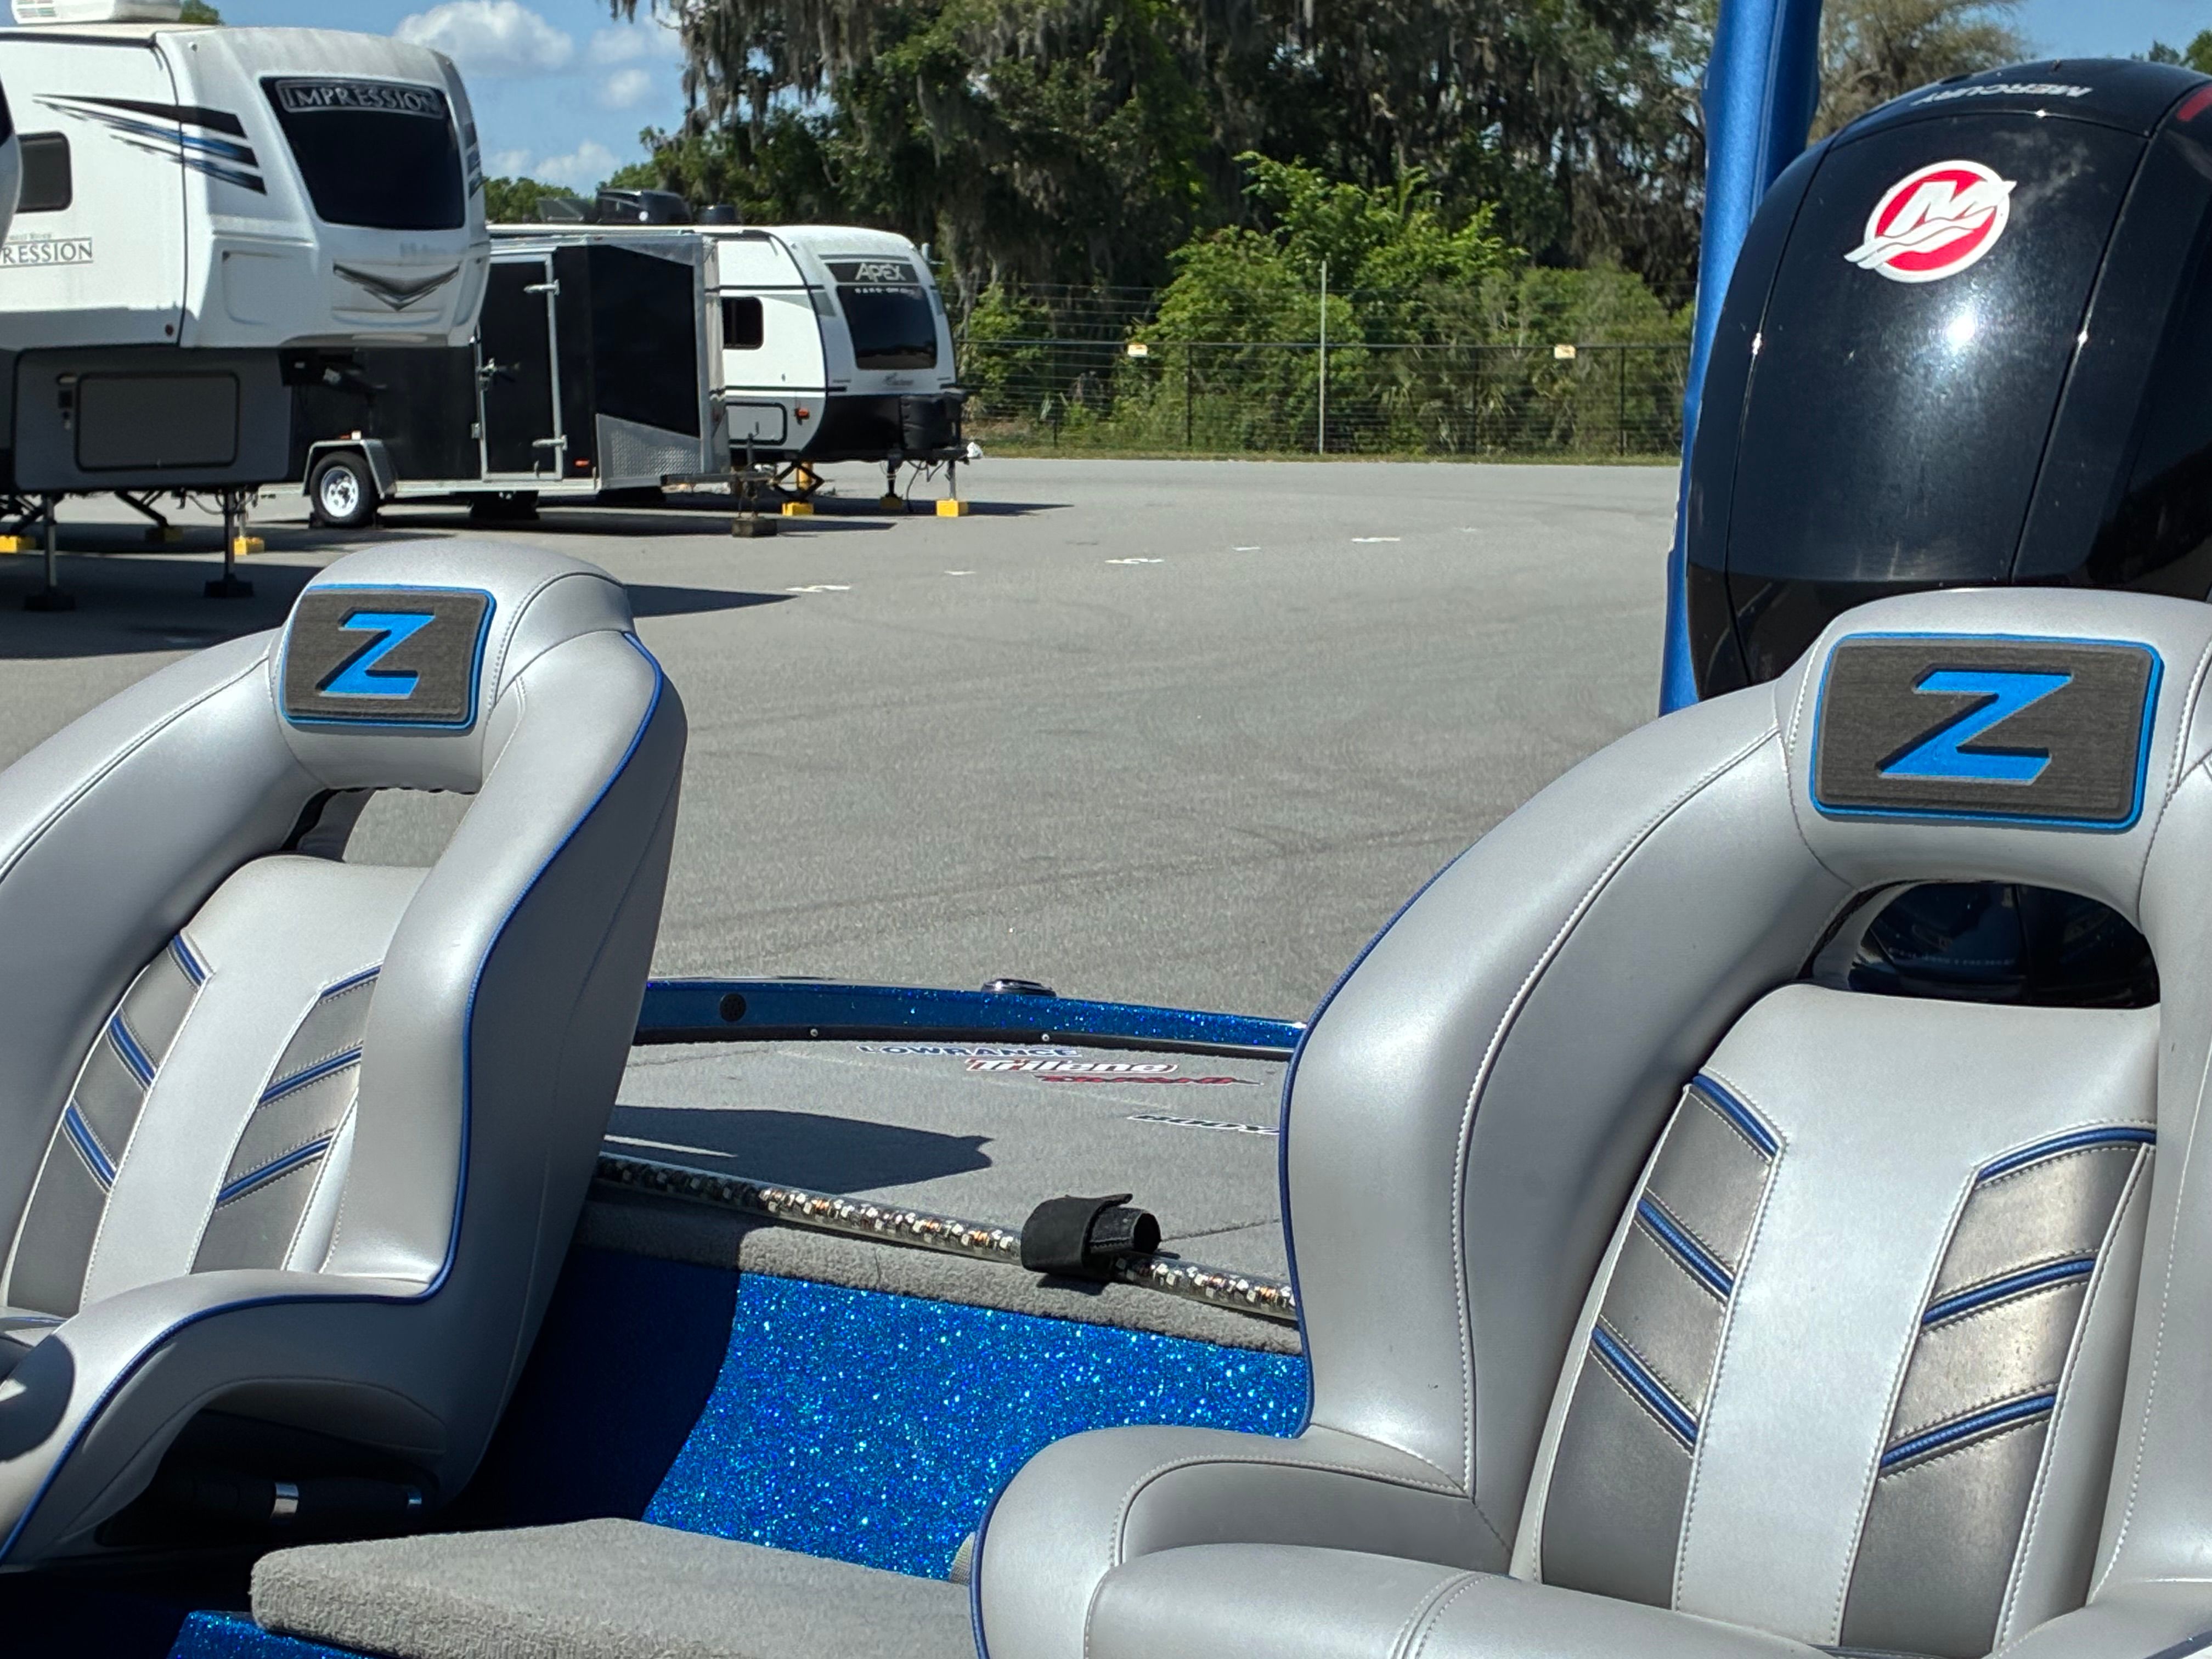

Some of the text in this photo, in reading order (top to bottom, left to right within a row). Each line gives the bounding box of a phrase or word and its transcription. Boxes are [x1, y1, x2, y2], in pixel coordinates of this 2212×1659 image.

[284, 87, 438, 113] IMPRESSION
[0, 241, 93, 264] RESSION
[319, 610, 436, 698] Z
[1876, 666, 2073, 783] Z
[857, 1046, 1082, 1057] LOWRANCE
